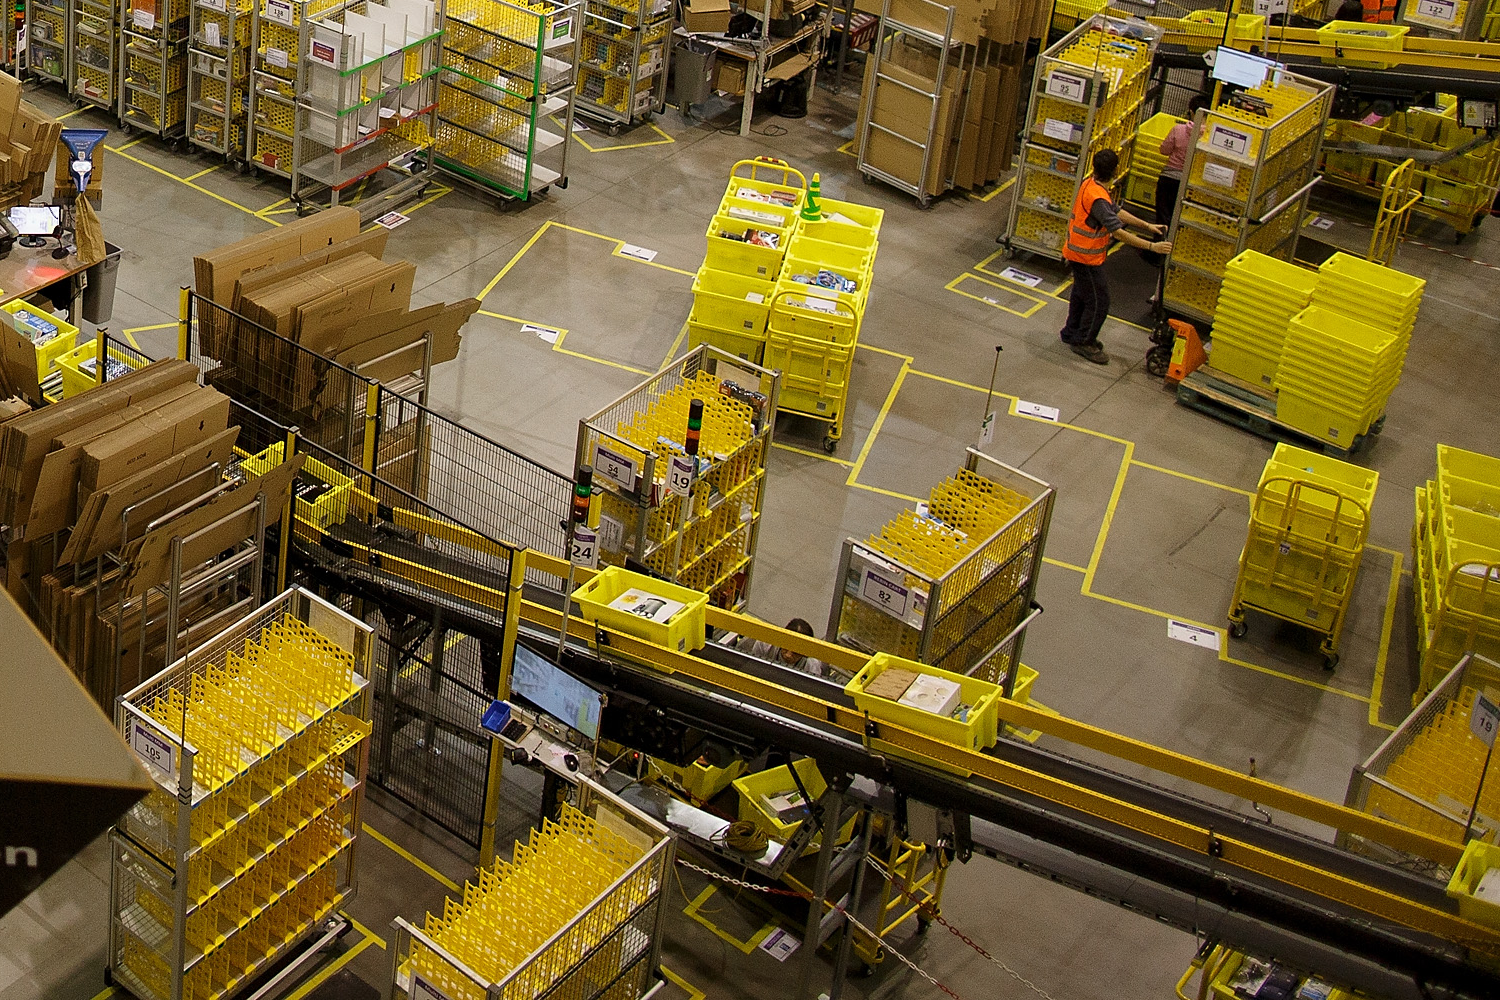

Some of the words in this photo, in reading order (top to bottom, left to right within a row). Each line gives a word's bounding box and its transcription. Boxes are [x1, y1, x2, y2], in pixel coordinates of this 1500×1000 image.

[1428, 4, 1444, 14] 122
[1060, 84, 1071, 92] 95
[608, 462, 619, 474] 54
[672, 472, 690, 489] 19
[573, 543, 592, 559] 24
[873, 575, 889, 586] REBIN
[878, 590, 891, 603] 82
[1479, 717, 1493, 733] 19
[144, 744, 160, 760] 105
